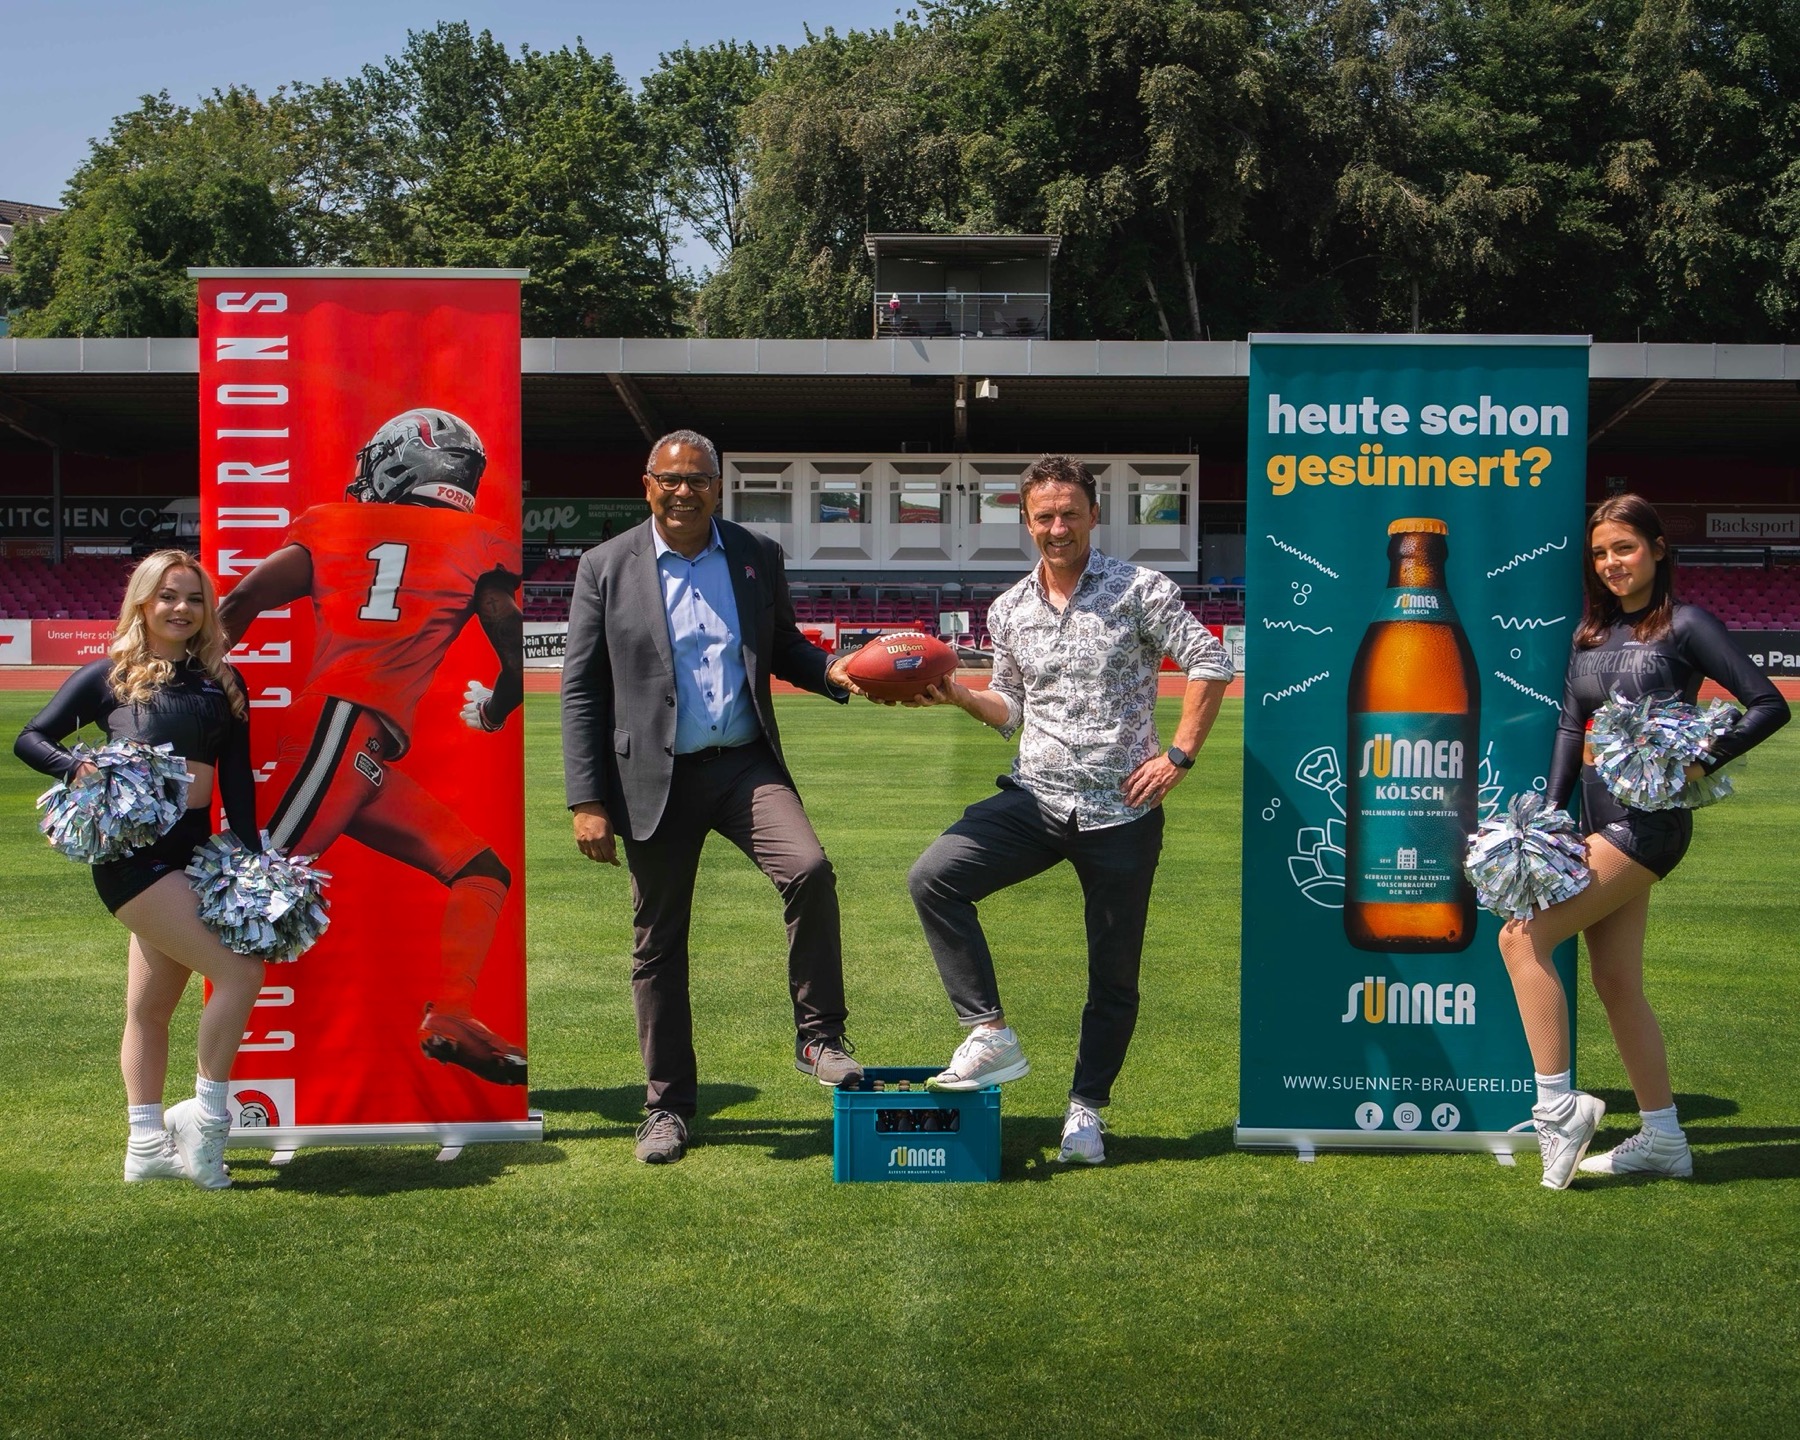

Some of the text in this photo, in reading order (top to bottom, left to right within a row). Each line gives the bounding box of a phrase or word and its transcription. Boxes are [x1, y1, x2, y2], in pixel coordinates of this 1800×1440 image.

[1268, 393, 1569, 436] heute schon
[1266, 443, 1552, 495] gesünnert?
[1711, 517, 1794, 536] Backsport
[358, 542, 409, 621] 1
[47, 630, 74, 640] Unser
[75, 631, 96, 640] Herz
[541, 635, 559, 645] Tor
[527, 646, 549, 658] Welt
[887, 643, 924, 655] Wilson
[1359, 734, 1464, 779] SÜNNER
[1376, 783, 1444, 800] KÖLSCH
[1361, 809, 1406, 817] VOLLMUNDIG
[1341, 976, 1476, 1025] SÜNNER
[1283, 1074, 1533, 1093] WWW.SUENNER-BRAUEREI.DE
[887, 1146, 946, 1167] SÜNNER
